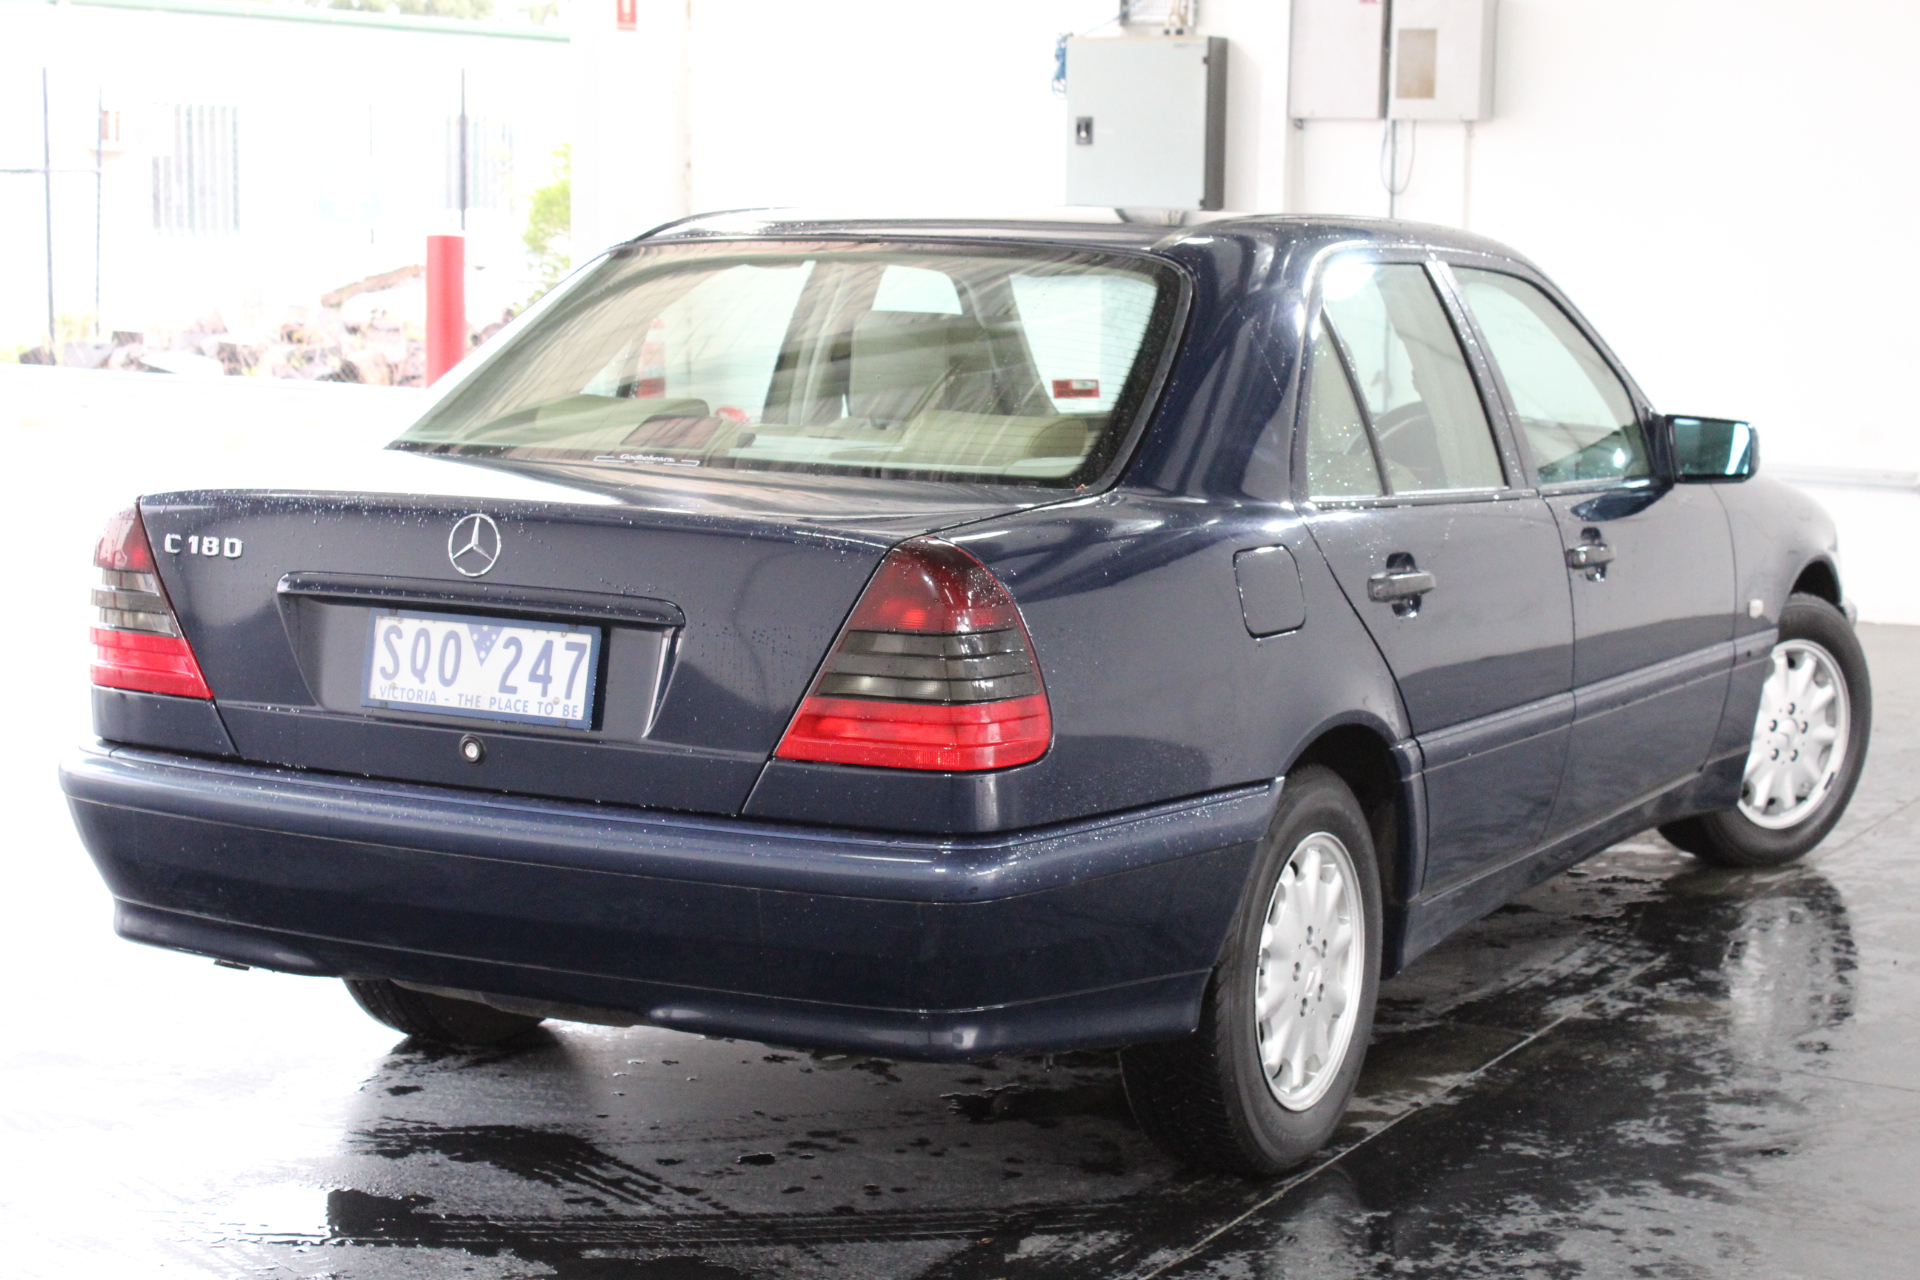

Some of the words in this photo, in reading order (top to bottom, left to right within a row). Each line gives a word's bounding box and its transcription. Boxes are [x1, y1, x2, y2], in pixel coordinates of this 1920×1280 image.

[164, 533, 182, 554] C
[188, 535, 243, 558] 180
[498, 636, 588, 700] 247
[379, 685, 437, 703] VICTORIA
[457, 693, 482, 708] THE
[488, 696, 529, 713] PLACE
[536, 701, 554, 716] TO
[562, 704, 579, 718] BE
